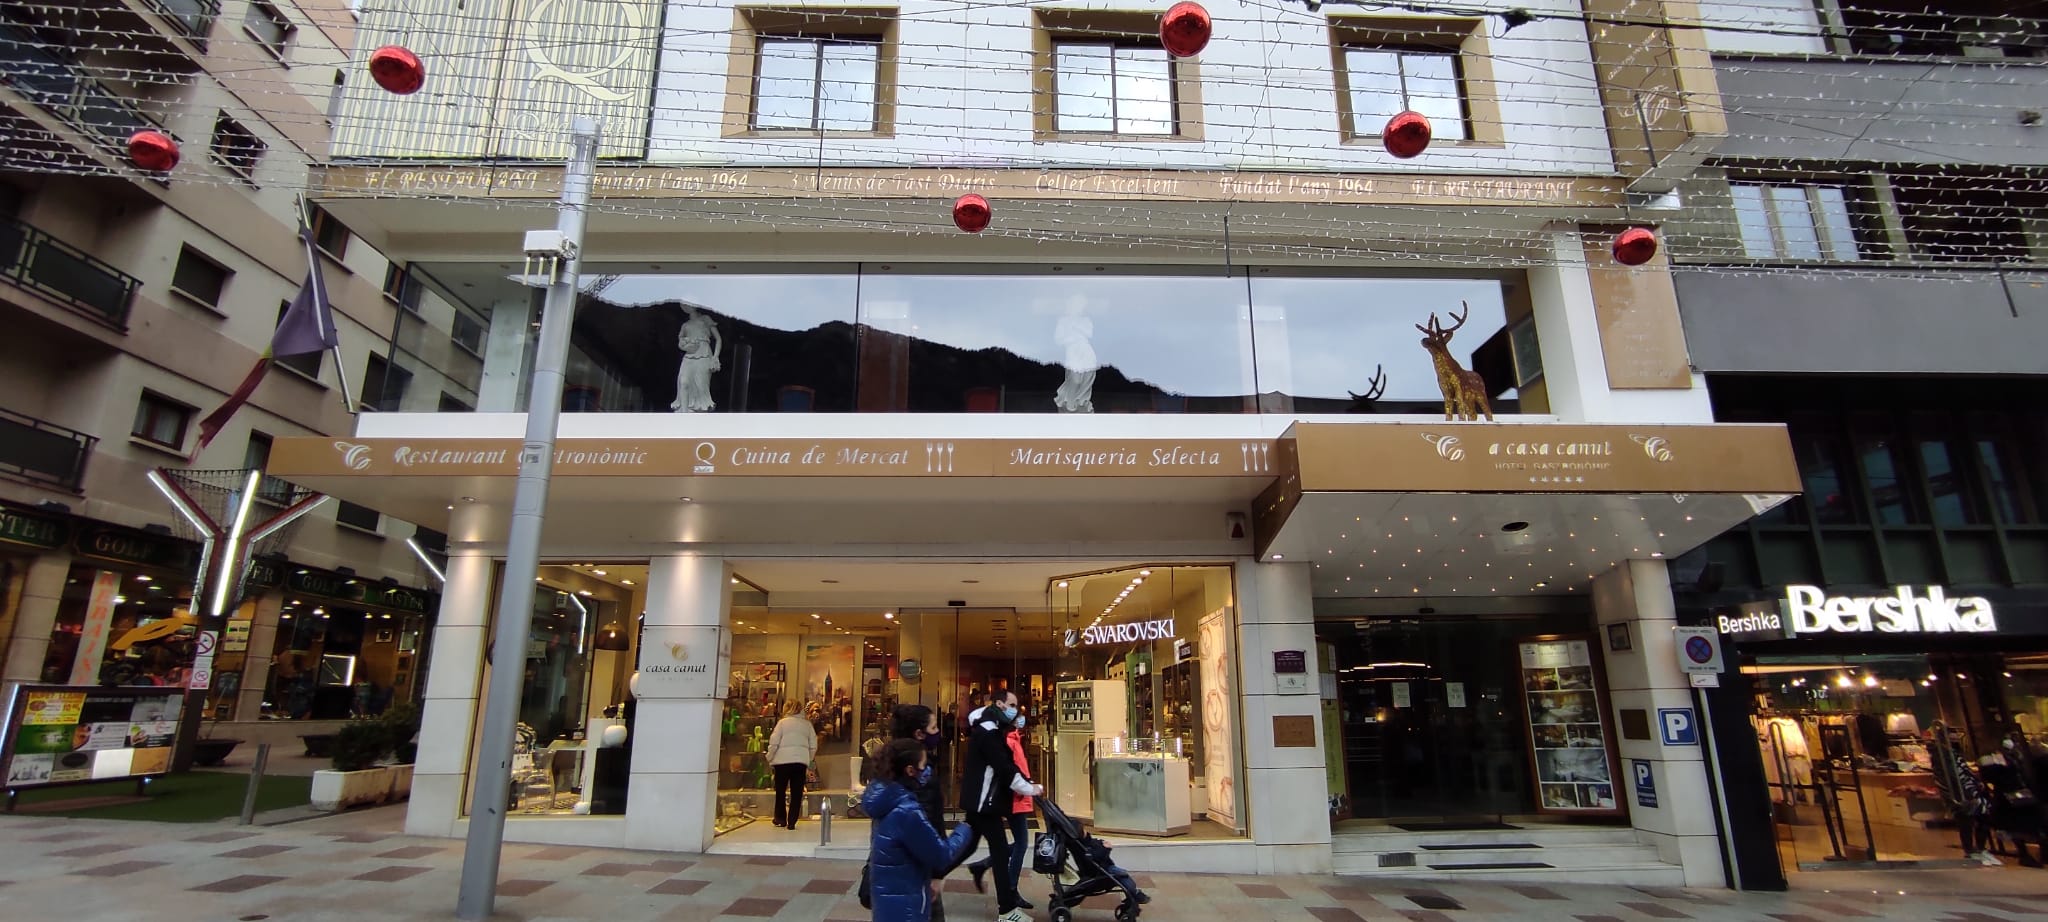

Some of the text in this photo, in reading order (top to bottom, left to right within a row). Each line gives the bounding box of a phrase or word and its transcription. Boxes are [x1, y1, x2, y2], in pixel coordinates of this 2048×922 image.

[400, 170, 539, 191] RESTAURANT
[711, 171, 749, 190] 1964
[866, 171, 885, 190] de
[890, 172, 932, 191] Tast
[937, 171, 997, 190] Diaris
[1036, 174, 1087, 193] Celler
[1219, 174, 1282, 195] Fundat
[1338, 178, 1374, 196] 1964
[1411, 178, 1576, 200] EL RESTAURANT
[394, 446, 507, 466] Restaurant
[731, 446, 792, 466] Cuina
[802, 444, 826, 465] de
[835, 446, 909, 466] Mercat
[1009, 445, 1221, 471] Marisqueria Selecta
[1488, 440, 1613, 456] a casa canut
[1494, 461, 1527, 471] HOTEL
[95, 533, 154, 560] GOLF
[303, 576, 338, 595] GOLF
[1785, 583, 1999, 634] Bershka
[1084, 617, 1177, 646] SWAROVSKI
[1718, 611, 1782, 635] Bershka
[645, 663, 707, 673] casa canut
[1665, 713, 1688, 741] P
[1635, 763, 1649, 785] P
